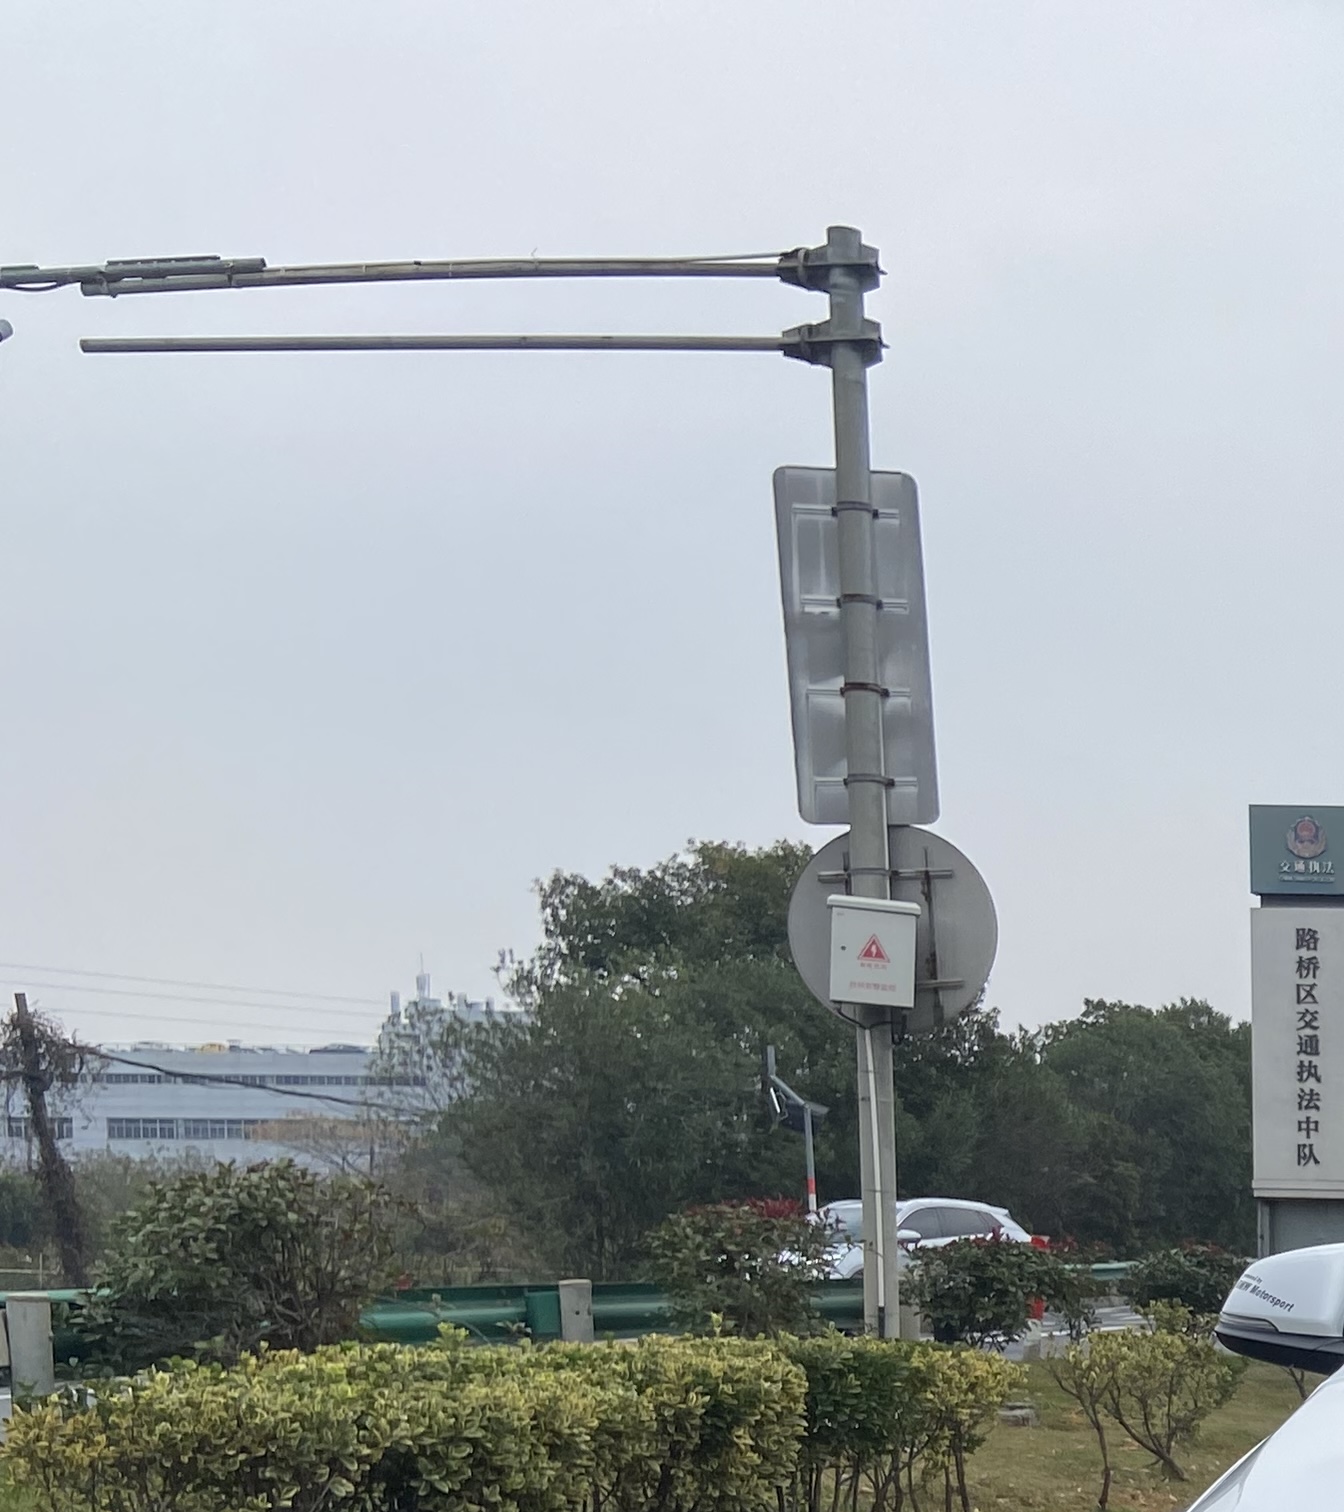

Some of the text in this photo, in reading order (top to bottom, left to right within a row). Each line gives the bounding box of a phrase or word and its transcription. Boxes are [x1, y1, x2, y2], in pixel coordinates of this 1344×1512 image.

[1295, 928, 1322, 1167] 路桥区交通执法中队
[1249, 1285, 1295, 1312] Motorsport
